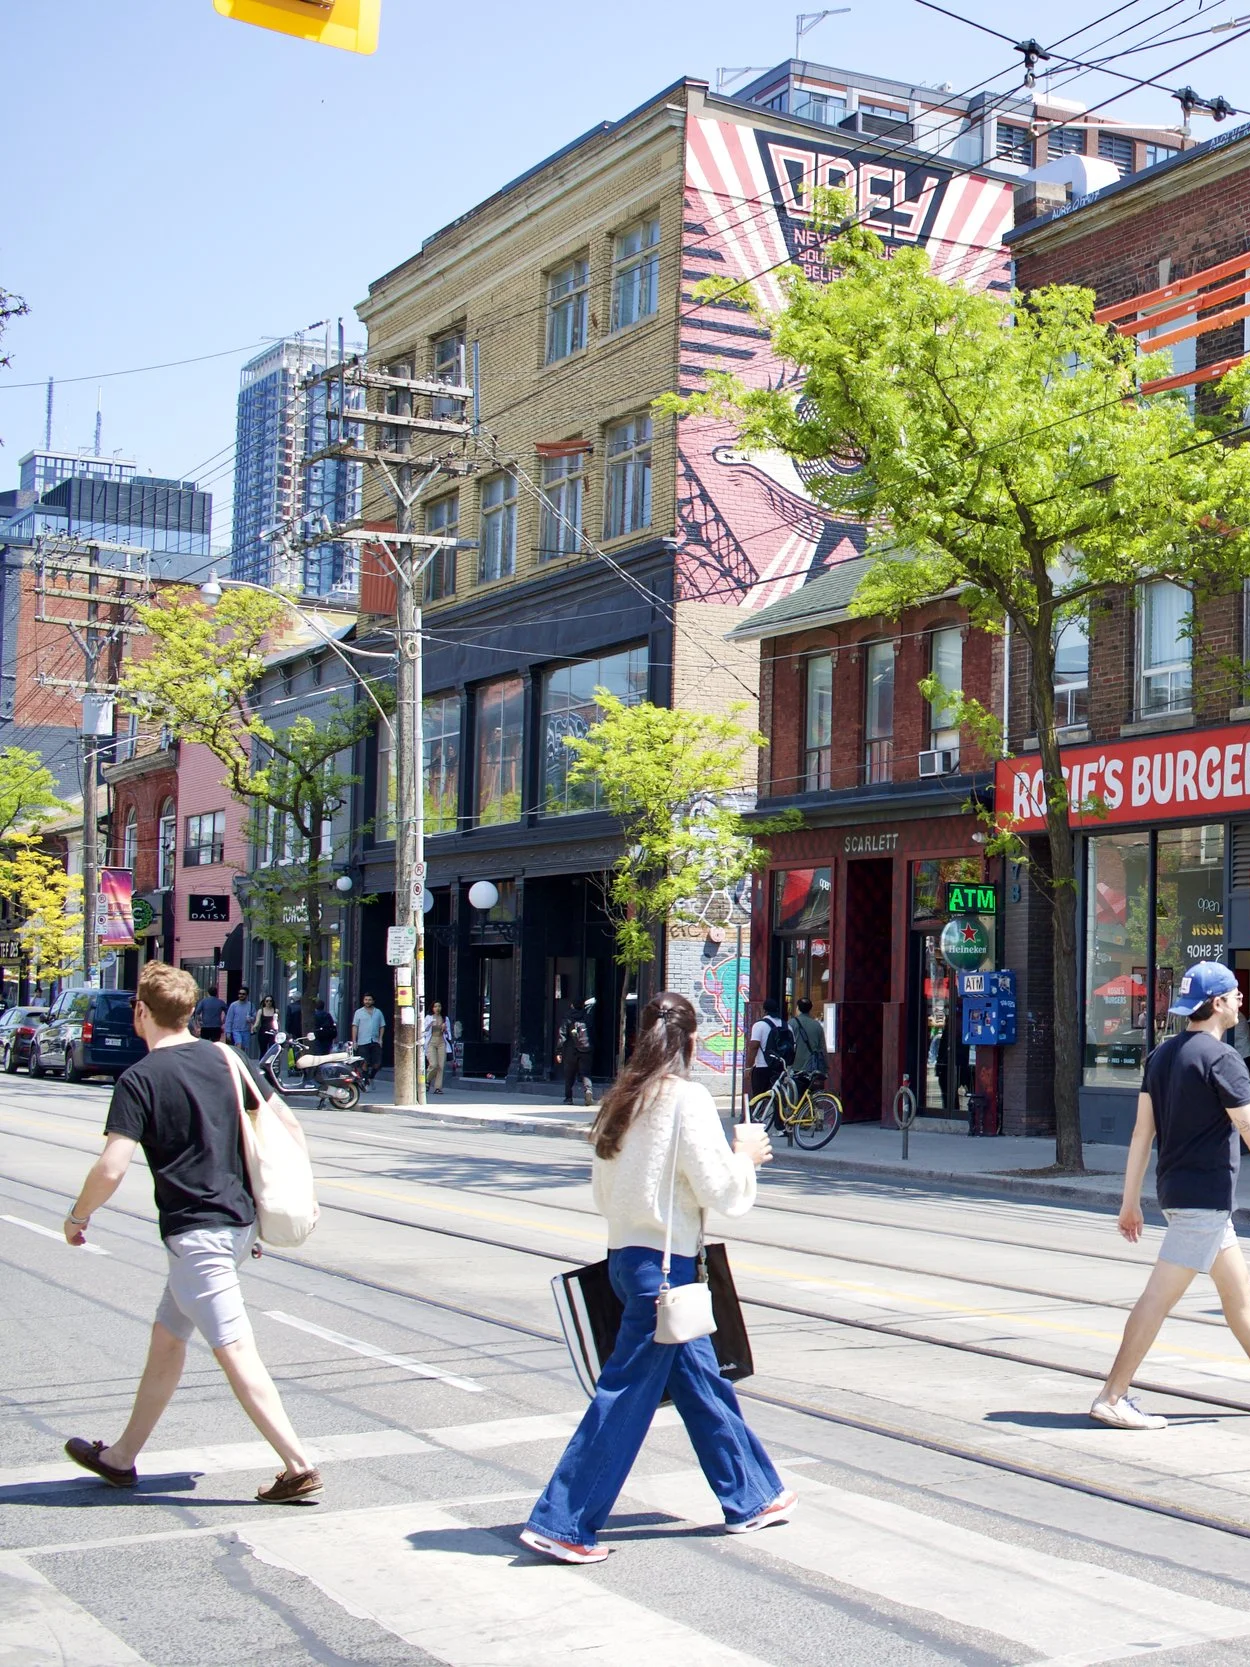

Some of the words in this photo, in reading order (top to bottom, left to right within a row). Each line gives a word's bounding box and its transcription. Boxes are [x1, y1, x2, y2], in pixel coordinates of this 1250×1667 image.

[767, 142, 940, 243] OBEY
[794, 227, 838, 247] NEV
[1012, 755, 1124, 820] ROIE'S
[844, 832, 899, 853] SCARLETT
[951, 888, 995, 909] ATM
[1197, 897, 1220, 913] open
[948, 945, 987, 954] Heineken
[965, 976, 984, 992] ATM
